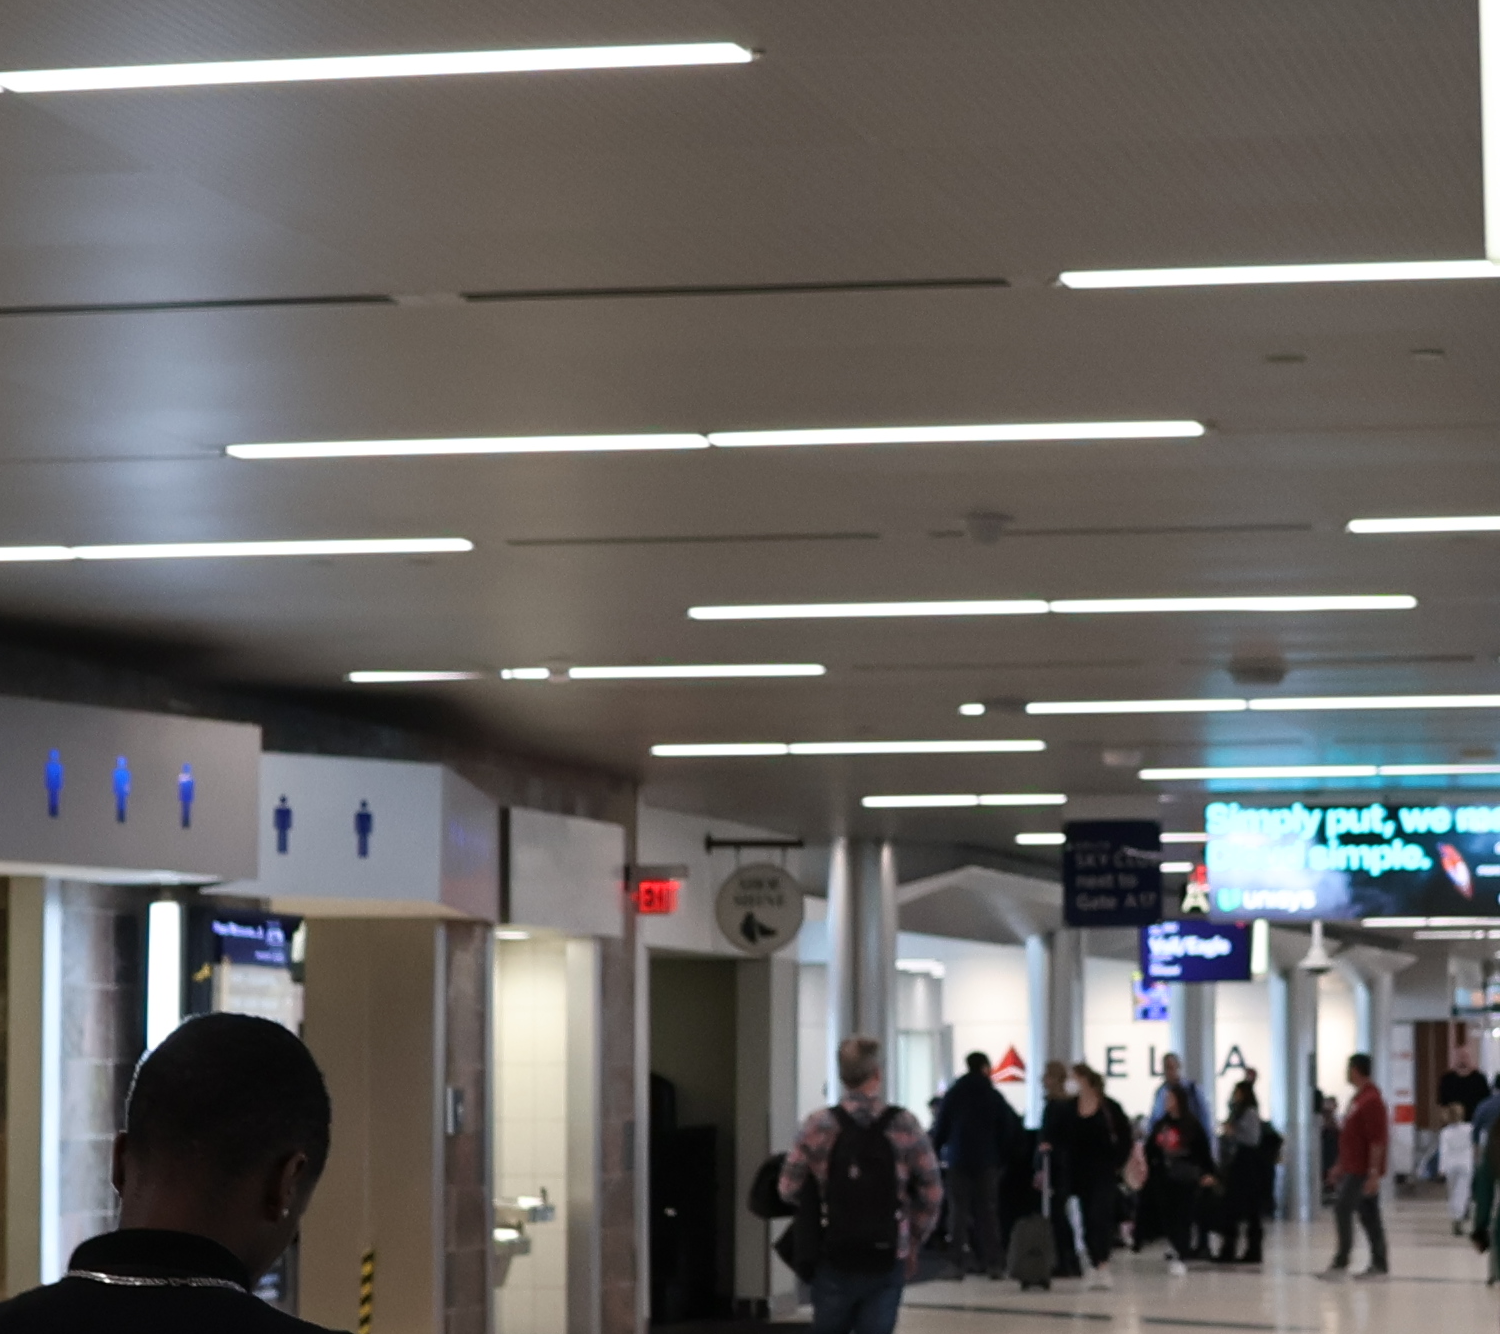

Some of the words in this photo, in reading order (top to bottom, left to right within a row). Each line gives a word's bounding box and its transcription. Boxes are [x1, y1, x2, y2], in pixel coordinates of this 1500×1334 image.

[1205, 801, 1322, 840] Simply
[1325, 802, 1396, 840] put,
[1399, 806, 1452, 834] we
[1308, 838, 1433, 877] simple.
[1075, 892, 1119, 911] Gate
